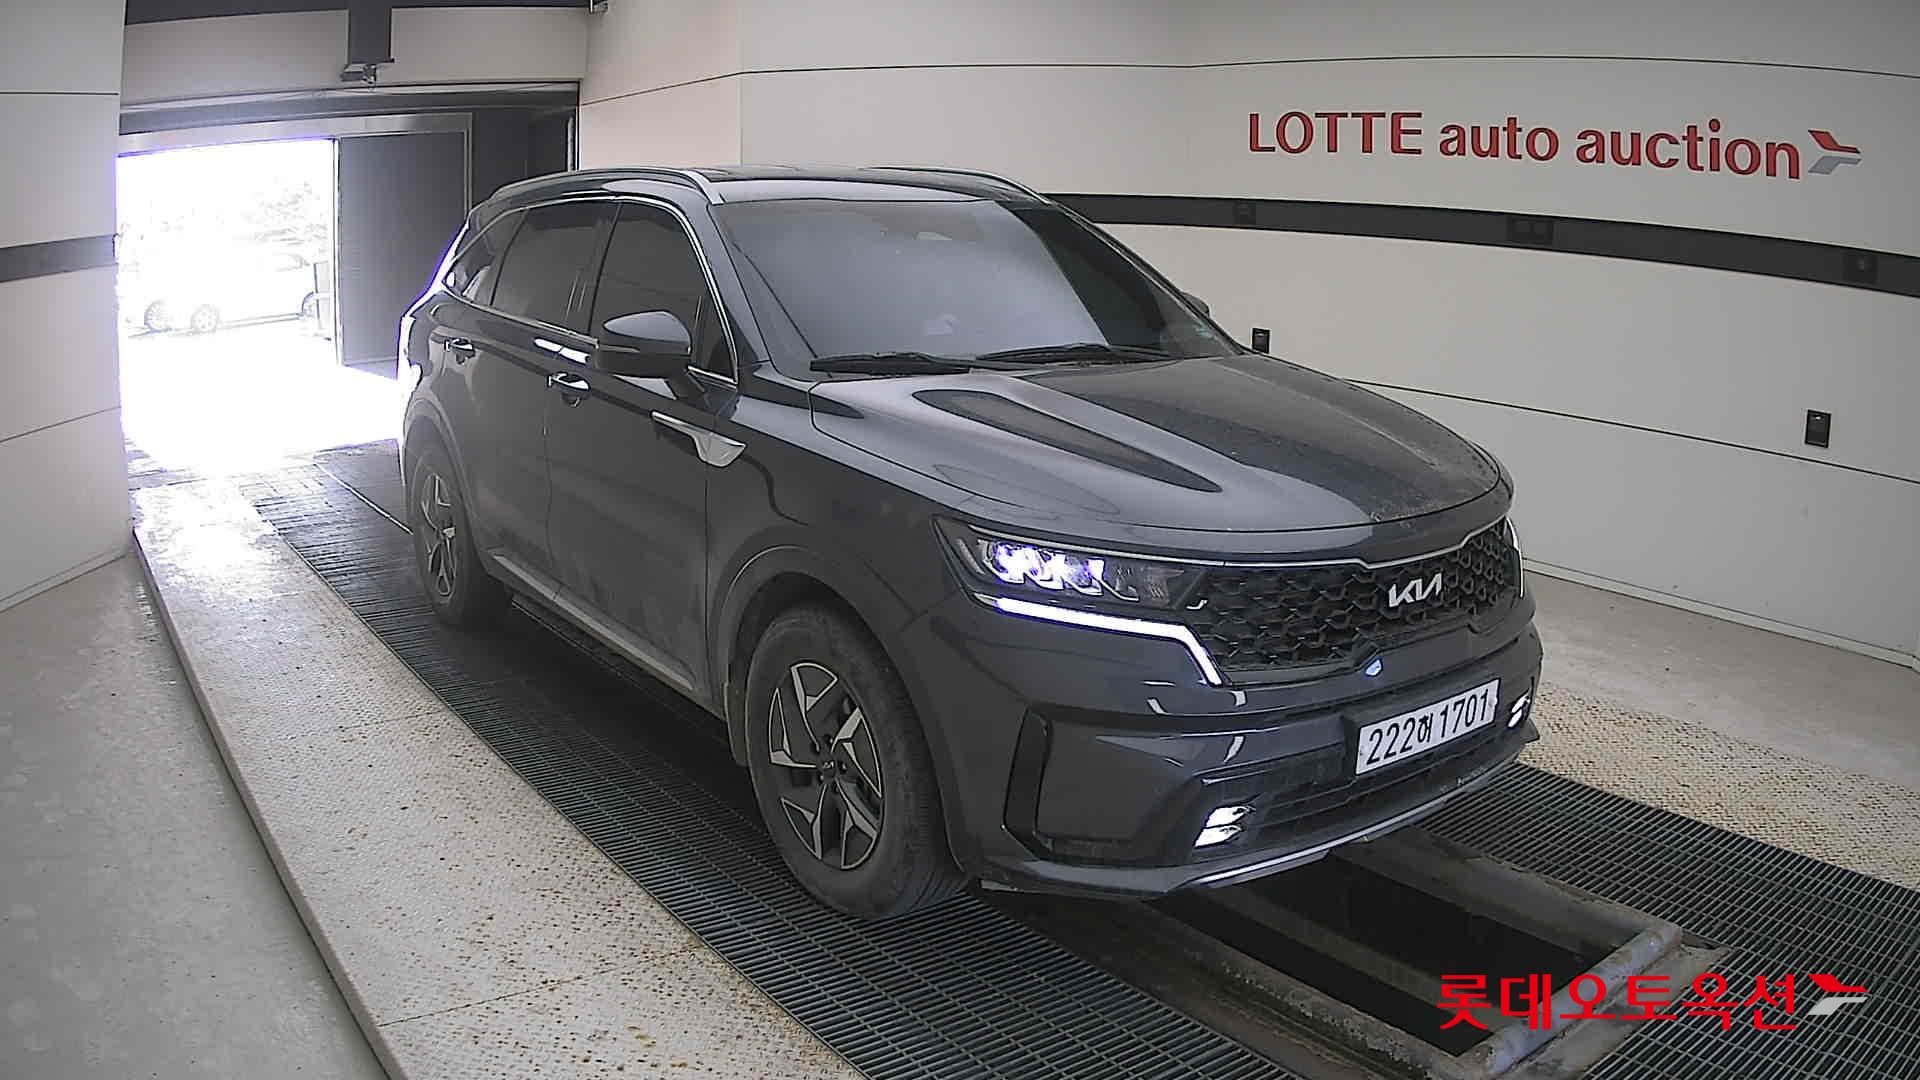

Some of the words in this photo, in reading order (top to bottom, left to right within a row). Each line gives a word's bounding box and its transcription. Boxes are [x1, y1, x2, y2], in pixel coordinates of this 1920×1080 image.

[1249, 112, 1423, 155] LOTTE
[1439, 116, 1560, 161] auto
[1575, 118, 1801, 180] auction
